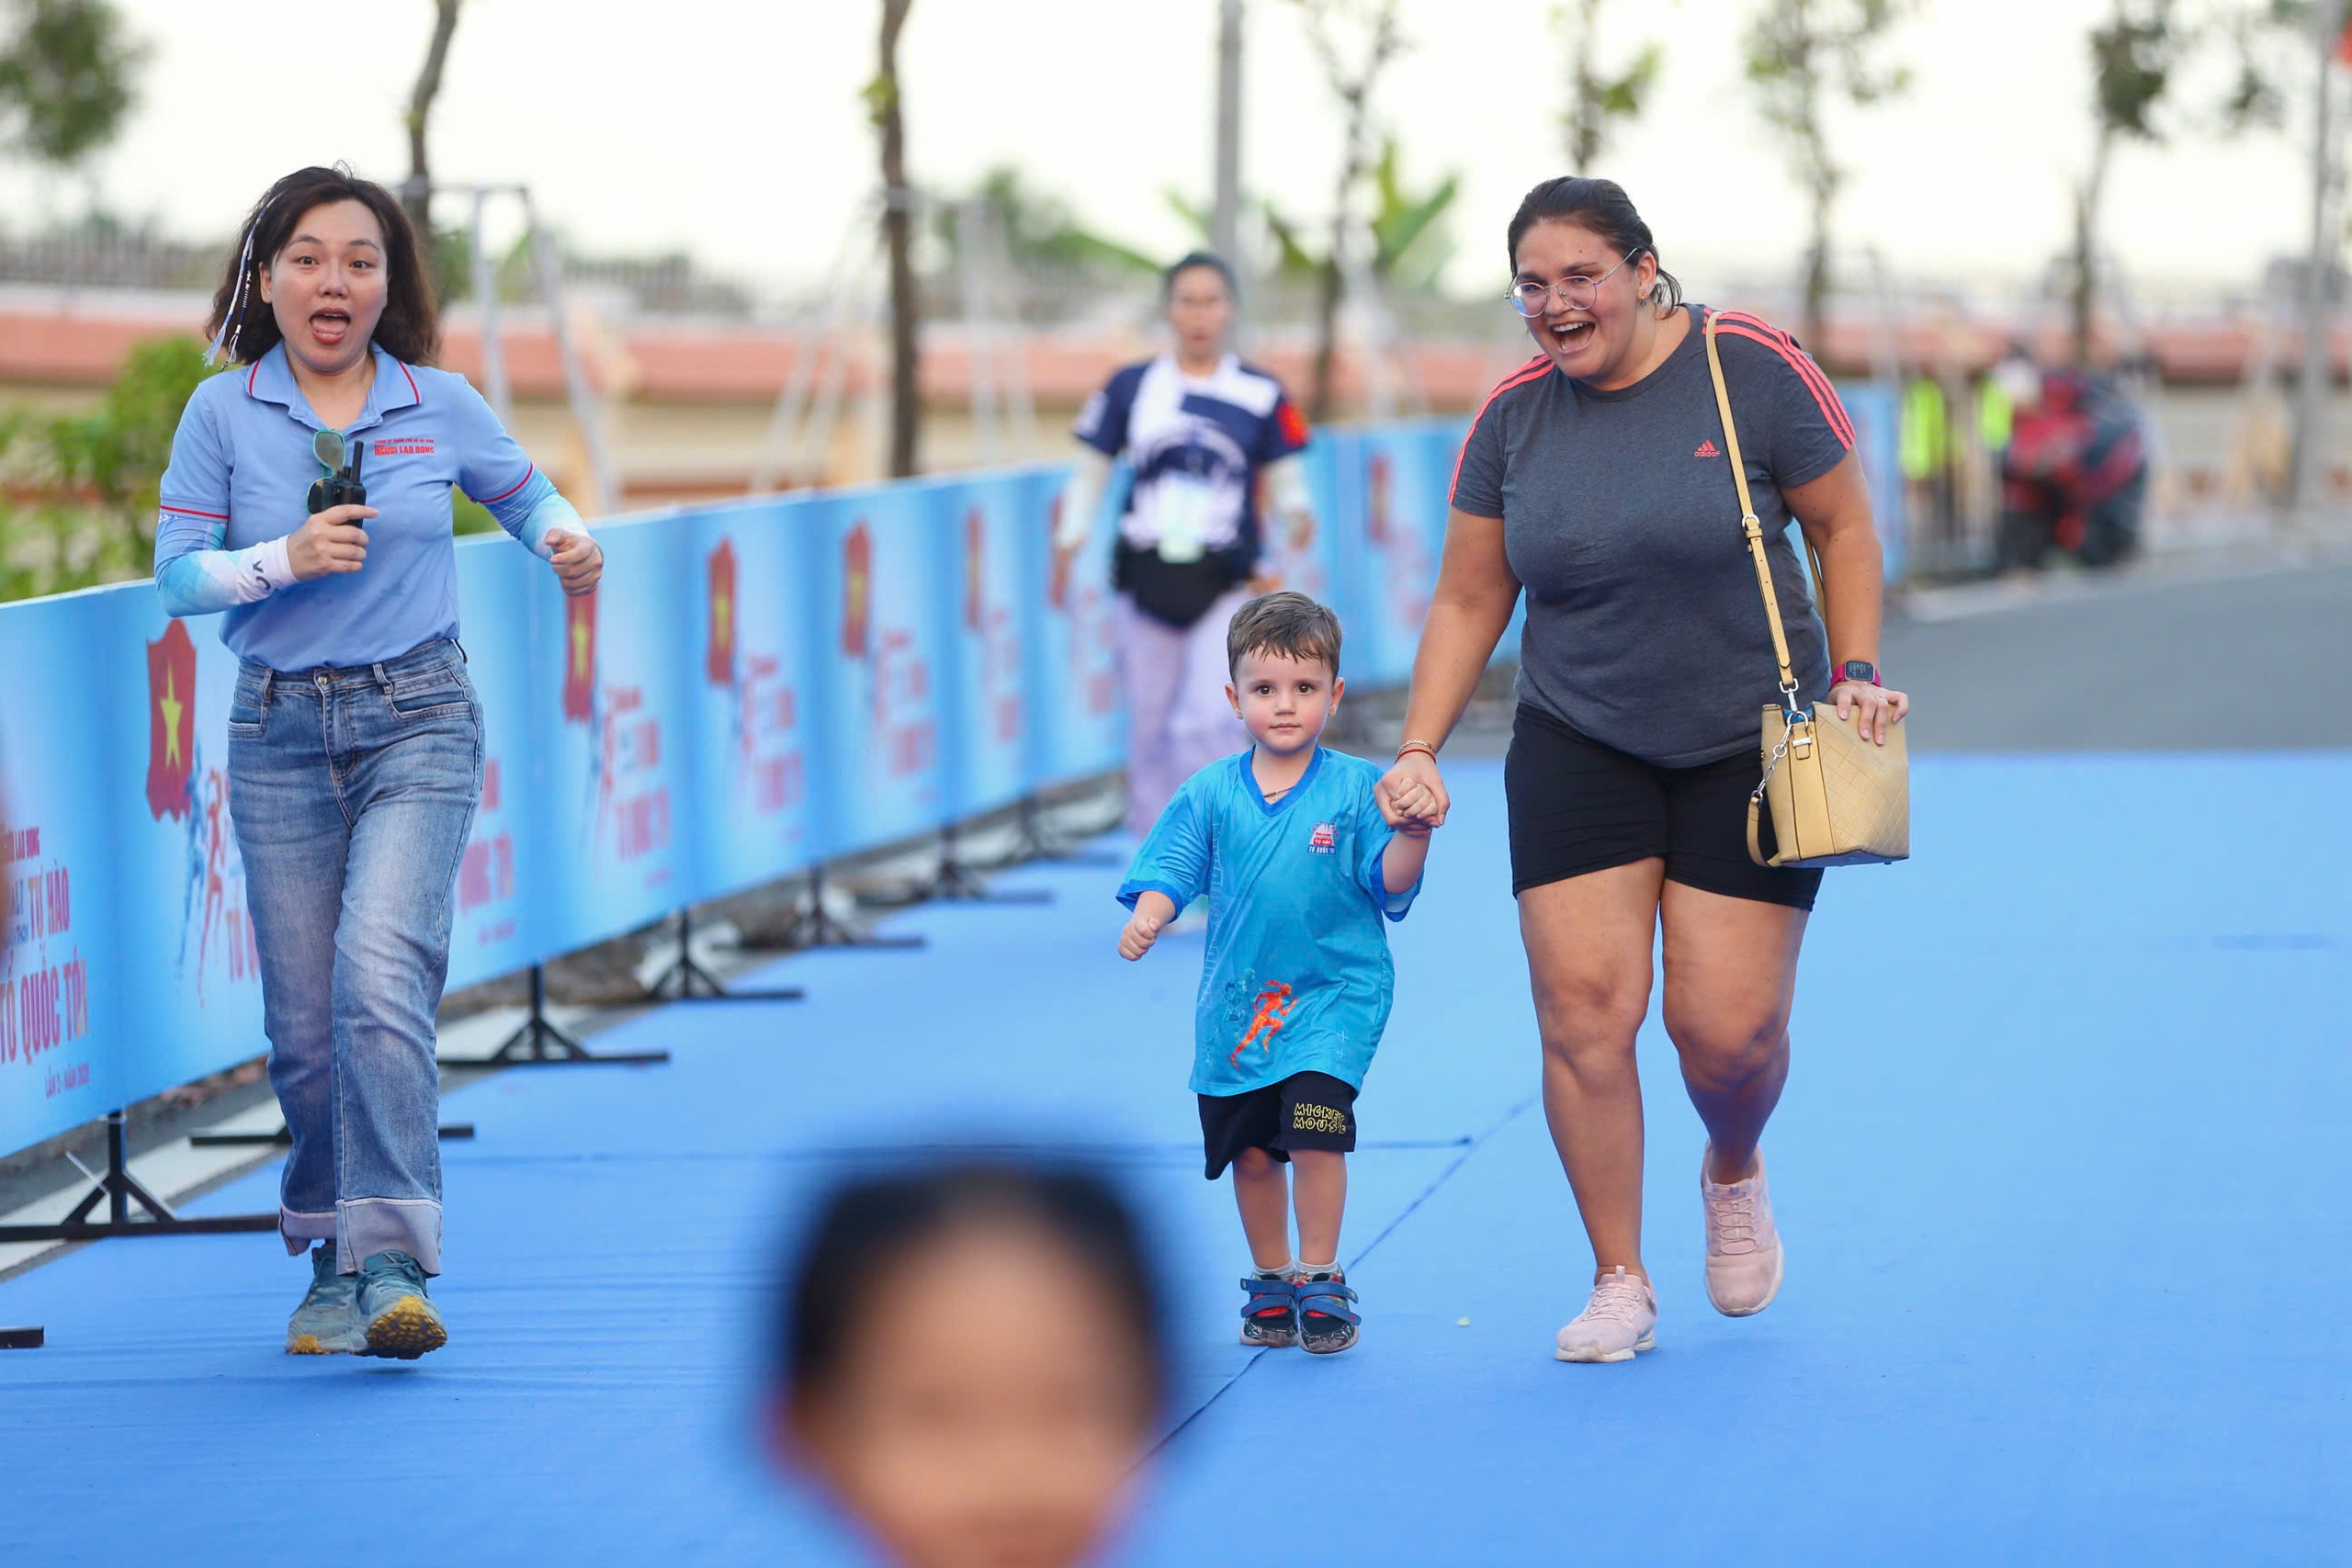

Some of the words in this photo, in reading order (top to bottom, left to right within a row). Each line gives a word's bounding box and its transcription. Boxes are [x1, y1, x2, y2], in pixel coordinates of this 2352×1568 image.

[46, 858, 70, 935] HÀO
[21, 942, 61, 1066] QUỐC
[1293, 1116, 1347, 1134] MOUSE
[1294, 1102, 1345, 1121] MICKEY
